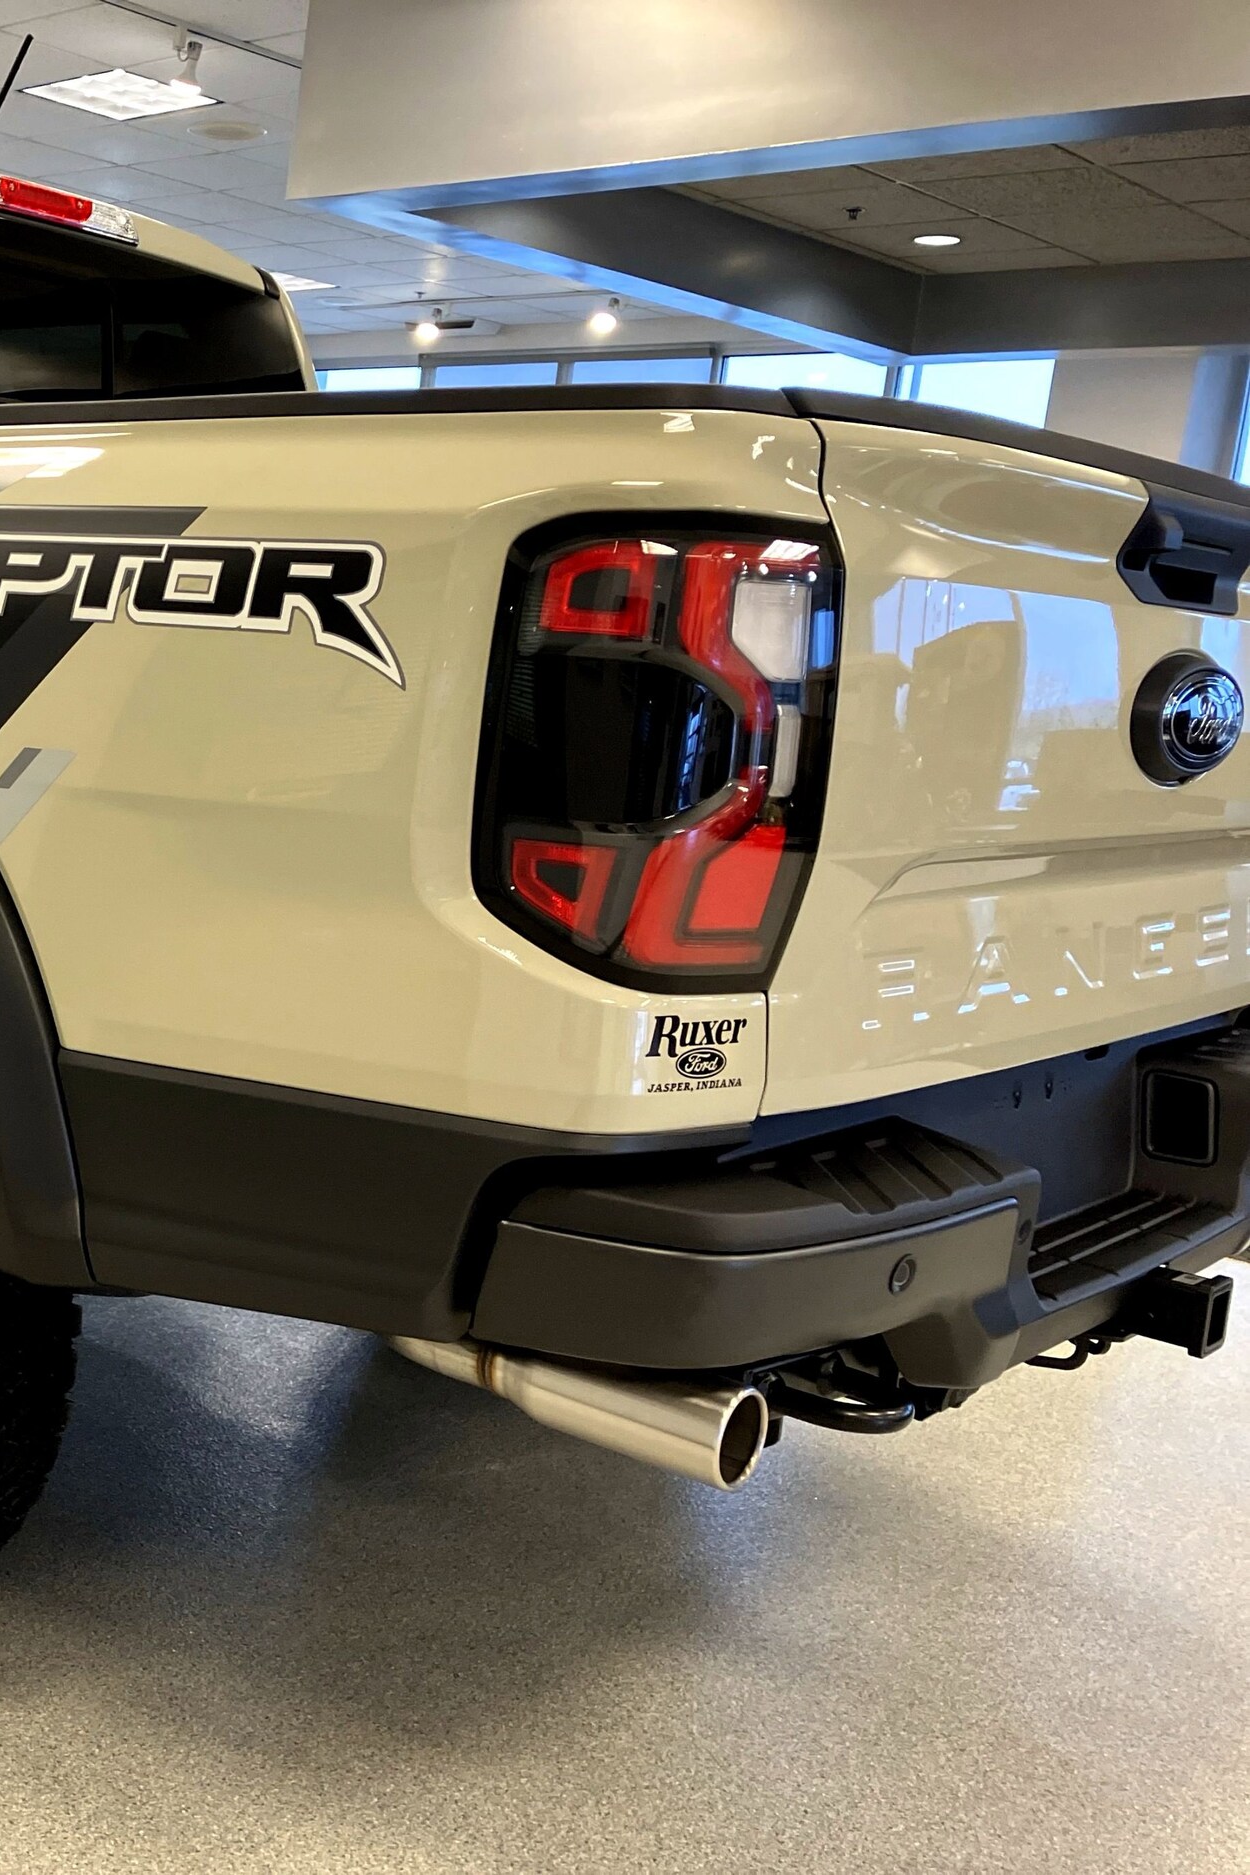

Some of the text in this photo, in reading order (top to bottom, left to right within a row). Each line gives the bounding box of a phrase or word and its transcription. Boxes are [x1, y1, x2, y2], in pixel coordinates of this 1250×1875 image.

[1186, 693, 1234, 745] Ford
[861, 897, 1250, 1029] RANGE
[646, 1015, 748, 1058] Ruxer
[684, 1053, 719, 1073] Ford
[647, 1078, 742, 1093] JASPER, INDIANA
